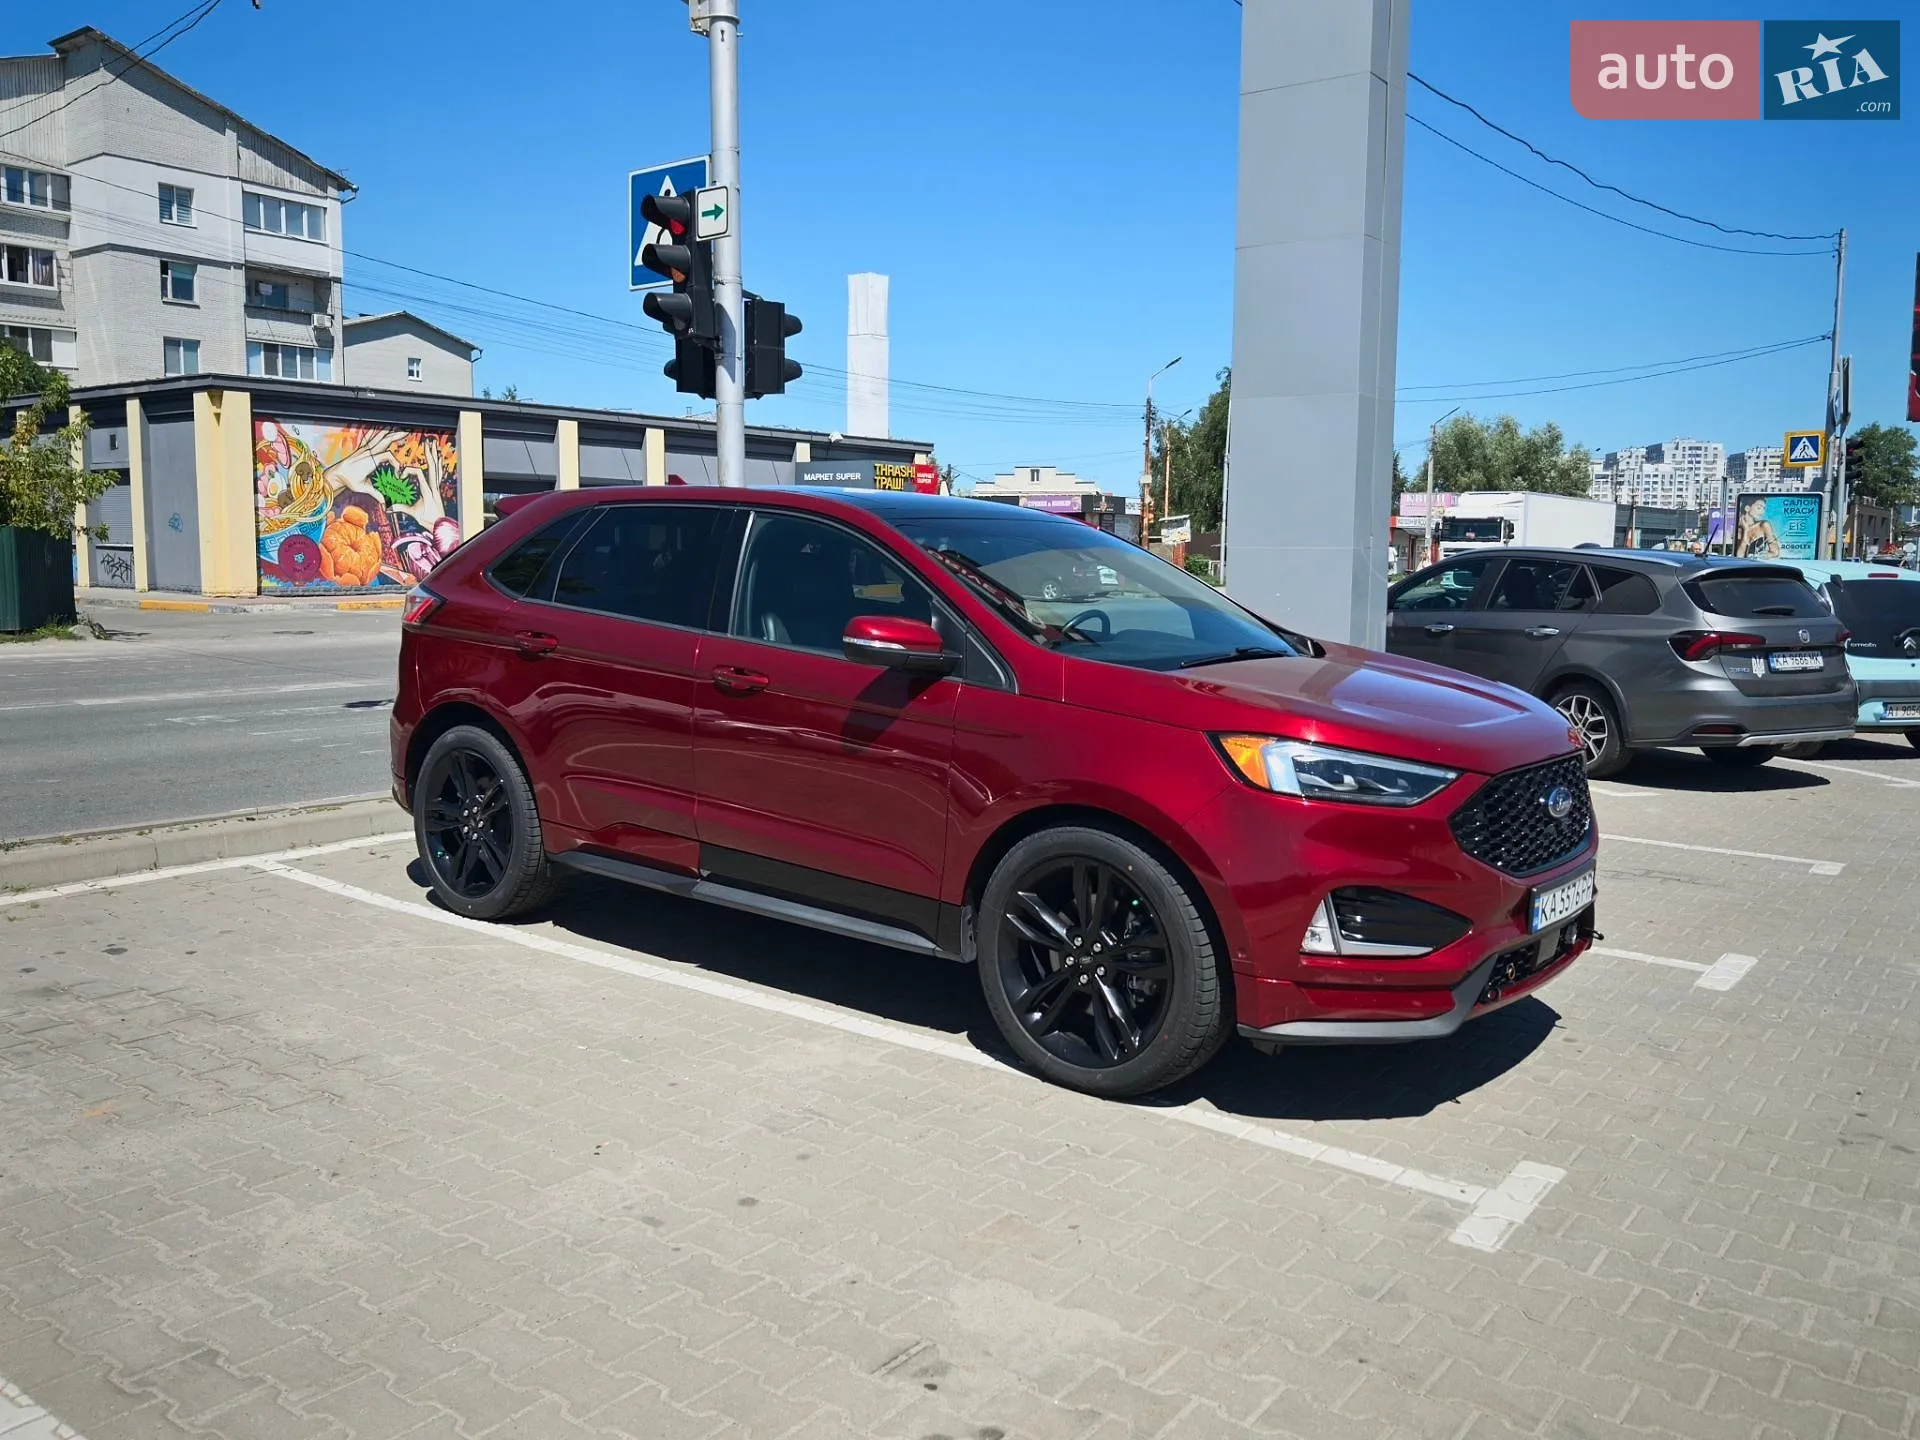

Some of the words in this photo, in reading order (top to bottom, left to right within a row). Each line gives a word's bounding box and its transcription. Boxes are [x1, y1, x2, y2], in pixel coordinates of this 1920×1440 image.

[836, 472, 862, 480] SUPER
[875, 463, 916, 478] THRASH!
[1783, 507, 1815, 515] КРАСИ
[1541, 893, 1557, 924] KA
